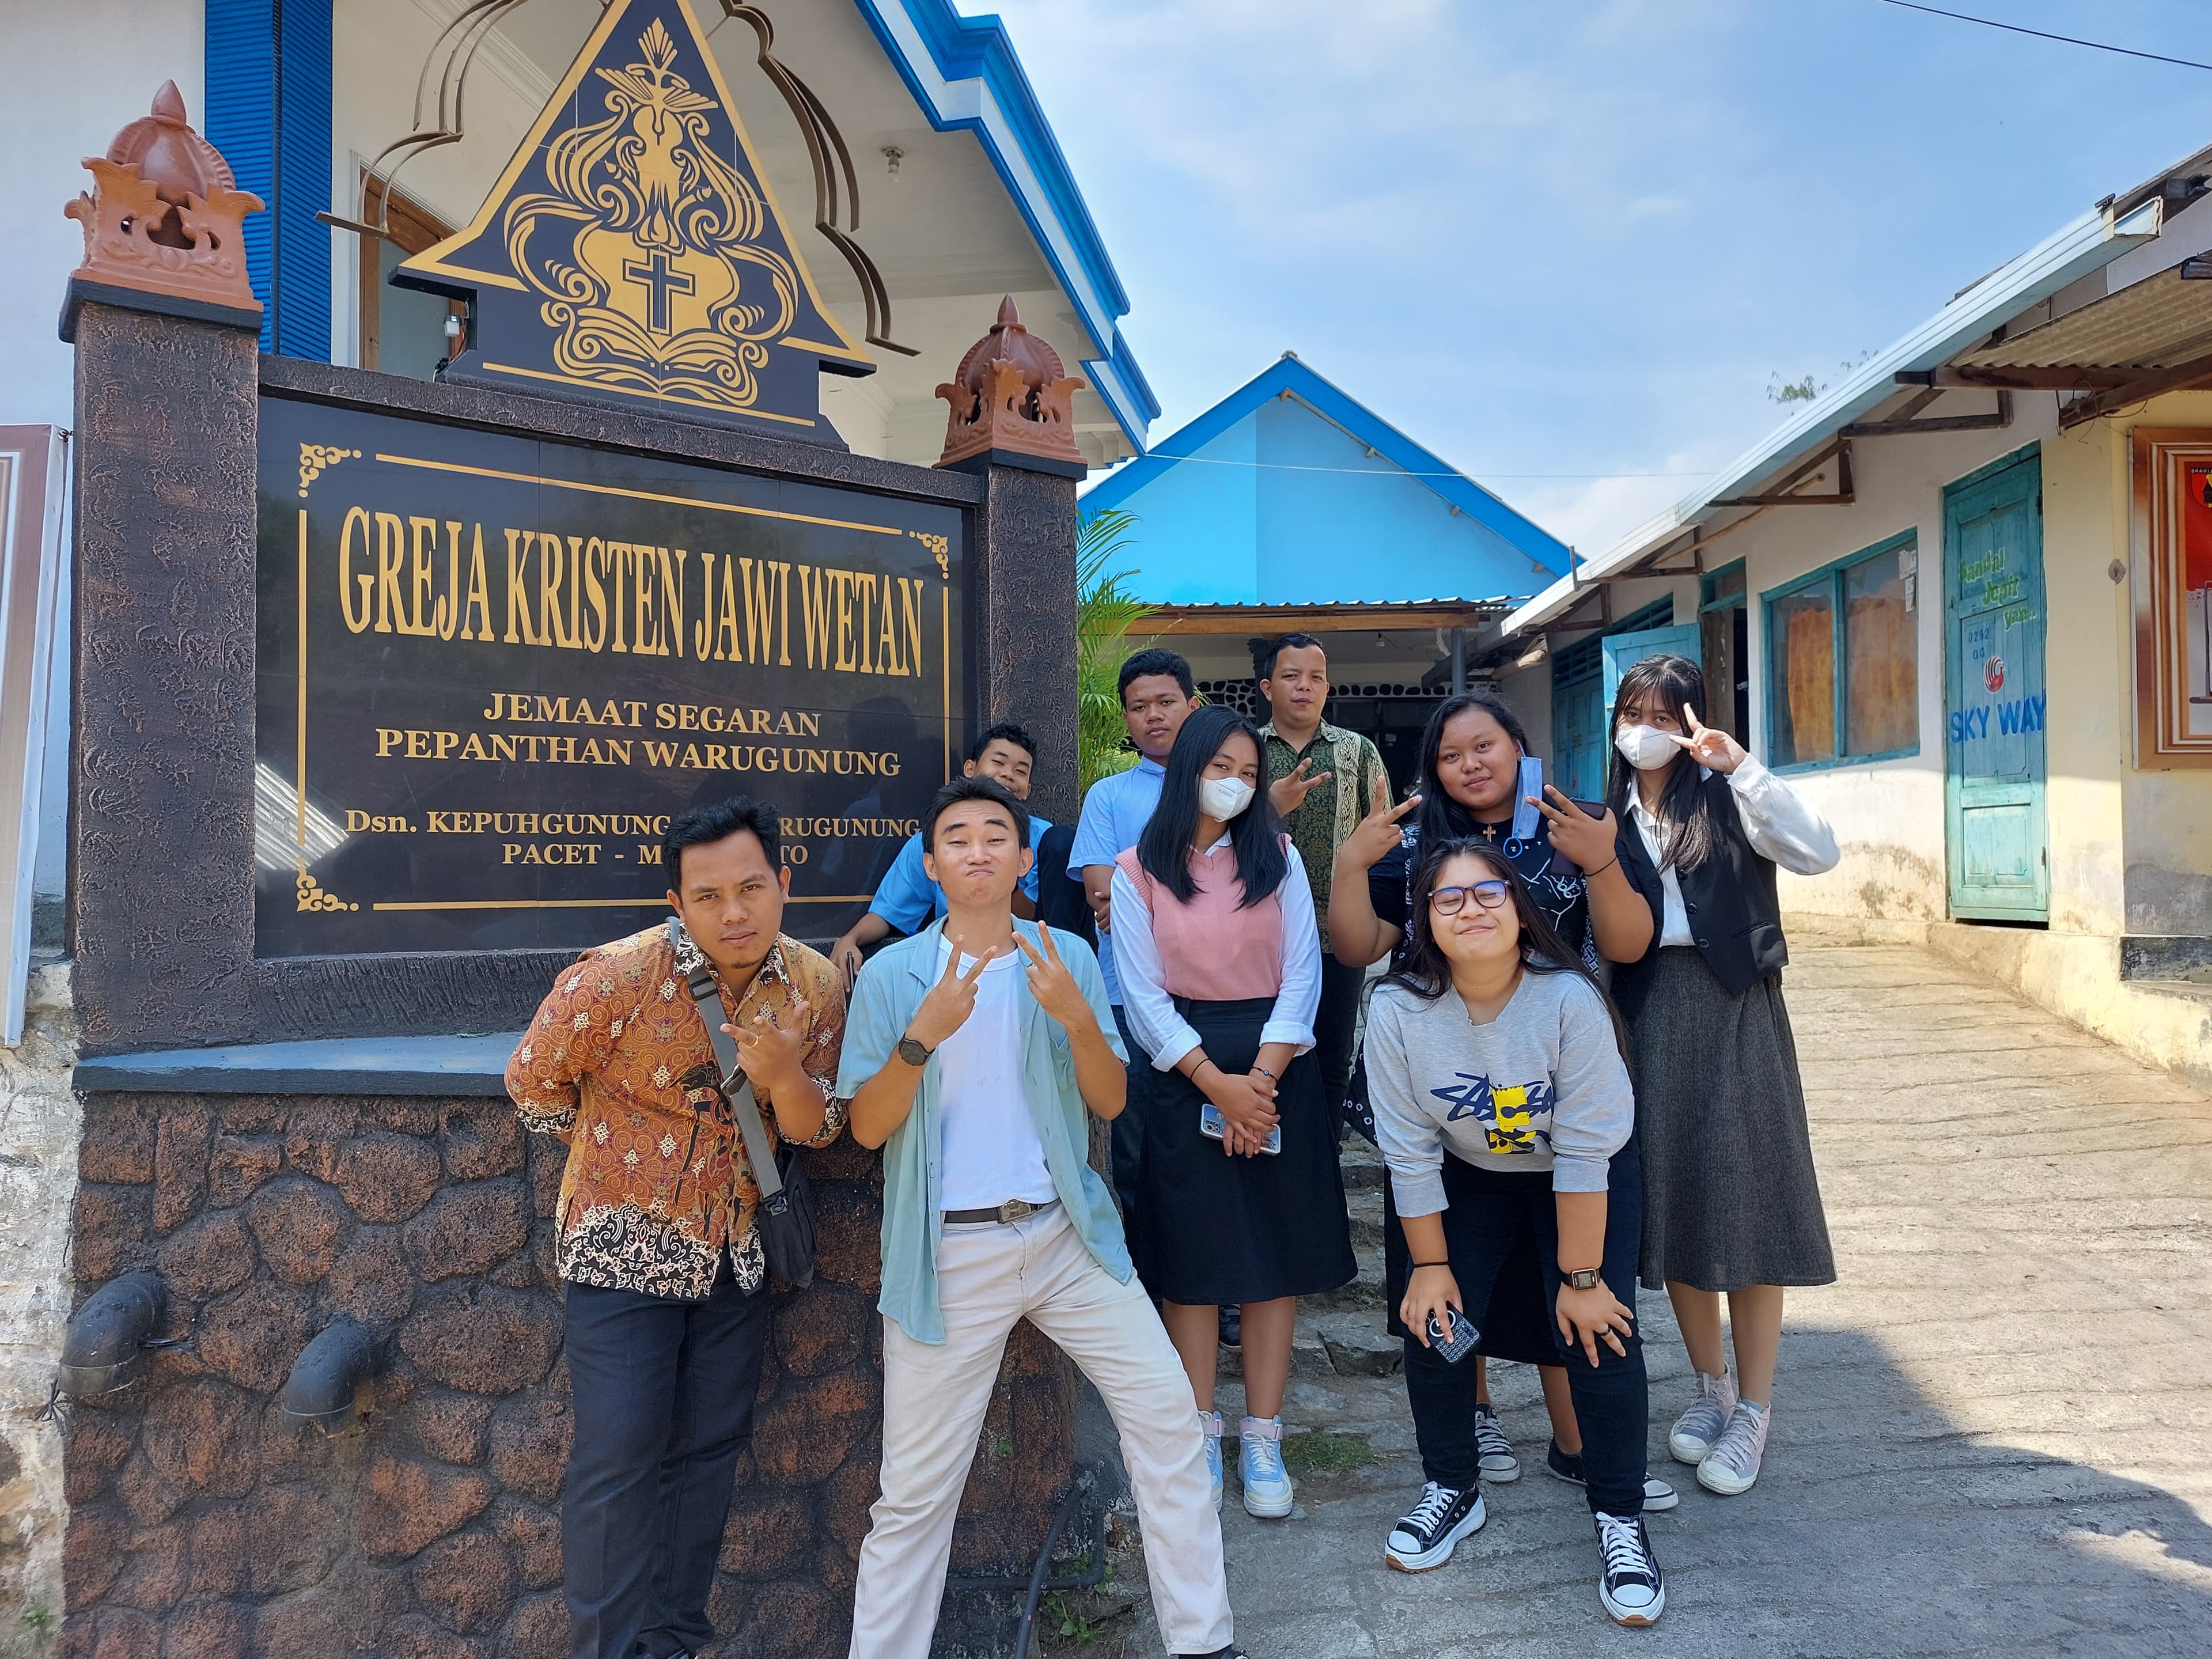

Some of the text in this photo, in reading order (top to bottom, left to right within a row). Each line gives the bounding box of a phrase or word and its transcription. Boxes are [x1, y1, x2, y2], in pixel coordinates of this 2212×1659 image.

[338, 506, 925, 678] GREJA KRISTEN JAWI WETAN
[483, 692, 822, 738] JEMAAT SEGARAN
[1950, 692, 2047, 743] SKY WAY
[375, 727, 902, 777] PEPANTHAN WARUGUNUNG
[346, 809, 922, 838] Dsn. KEPUHGUNUNG RUGUNUNG
[502, 843, 602, 865] PACET
